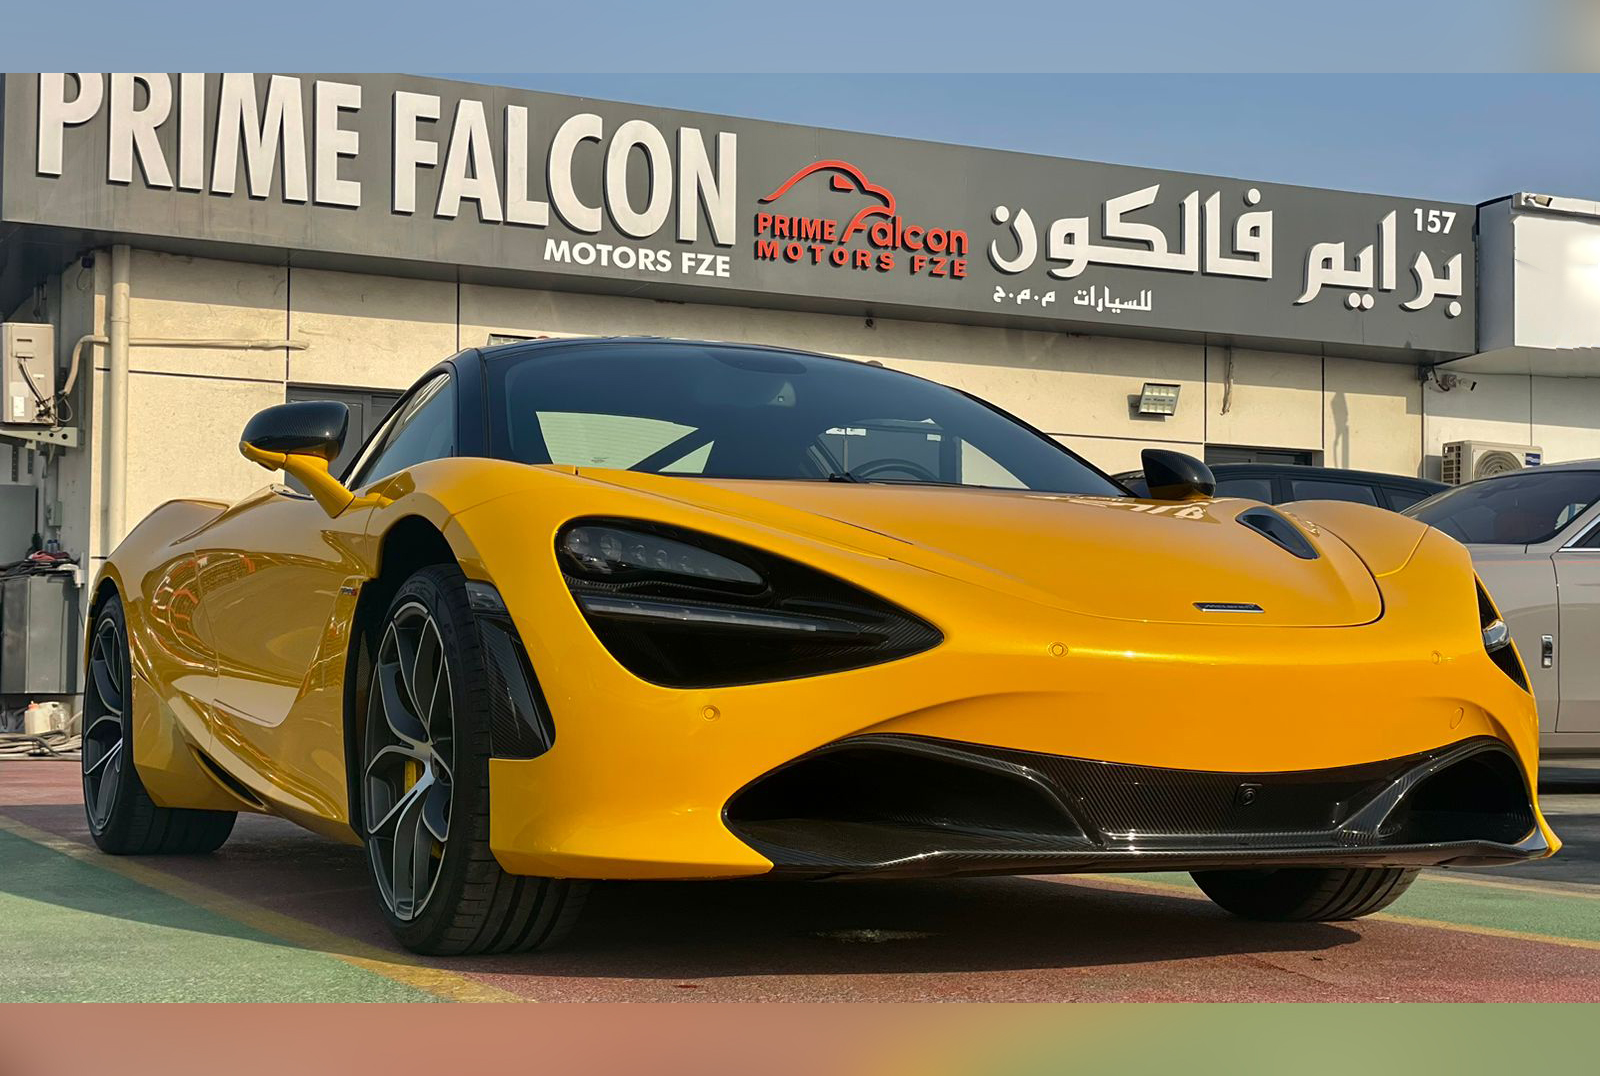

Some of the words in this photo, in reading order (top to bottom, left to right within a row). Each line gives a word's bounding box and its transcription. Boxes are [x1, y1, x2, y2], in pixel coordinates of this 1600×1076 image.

[37, 73, 362, 207] PRIME
[392, 90, 738, 246] FALCON
[757, 212, 837, 242] PRIME
[991, 184, 1273, 279] فالكون
[1413, 207, 1456, 235] 157
[543, 239, 672, 273] MOTORS
[681, 252, 731, 278] FZE
[757, 240, 895, 271] MOTORS
[913, 254, 968, 278] FZE
[1298, 209, 1462, 317] برايم
[1073, 285, 1152, 314] للسيارات
